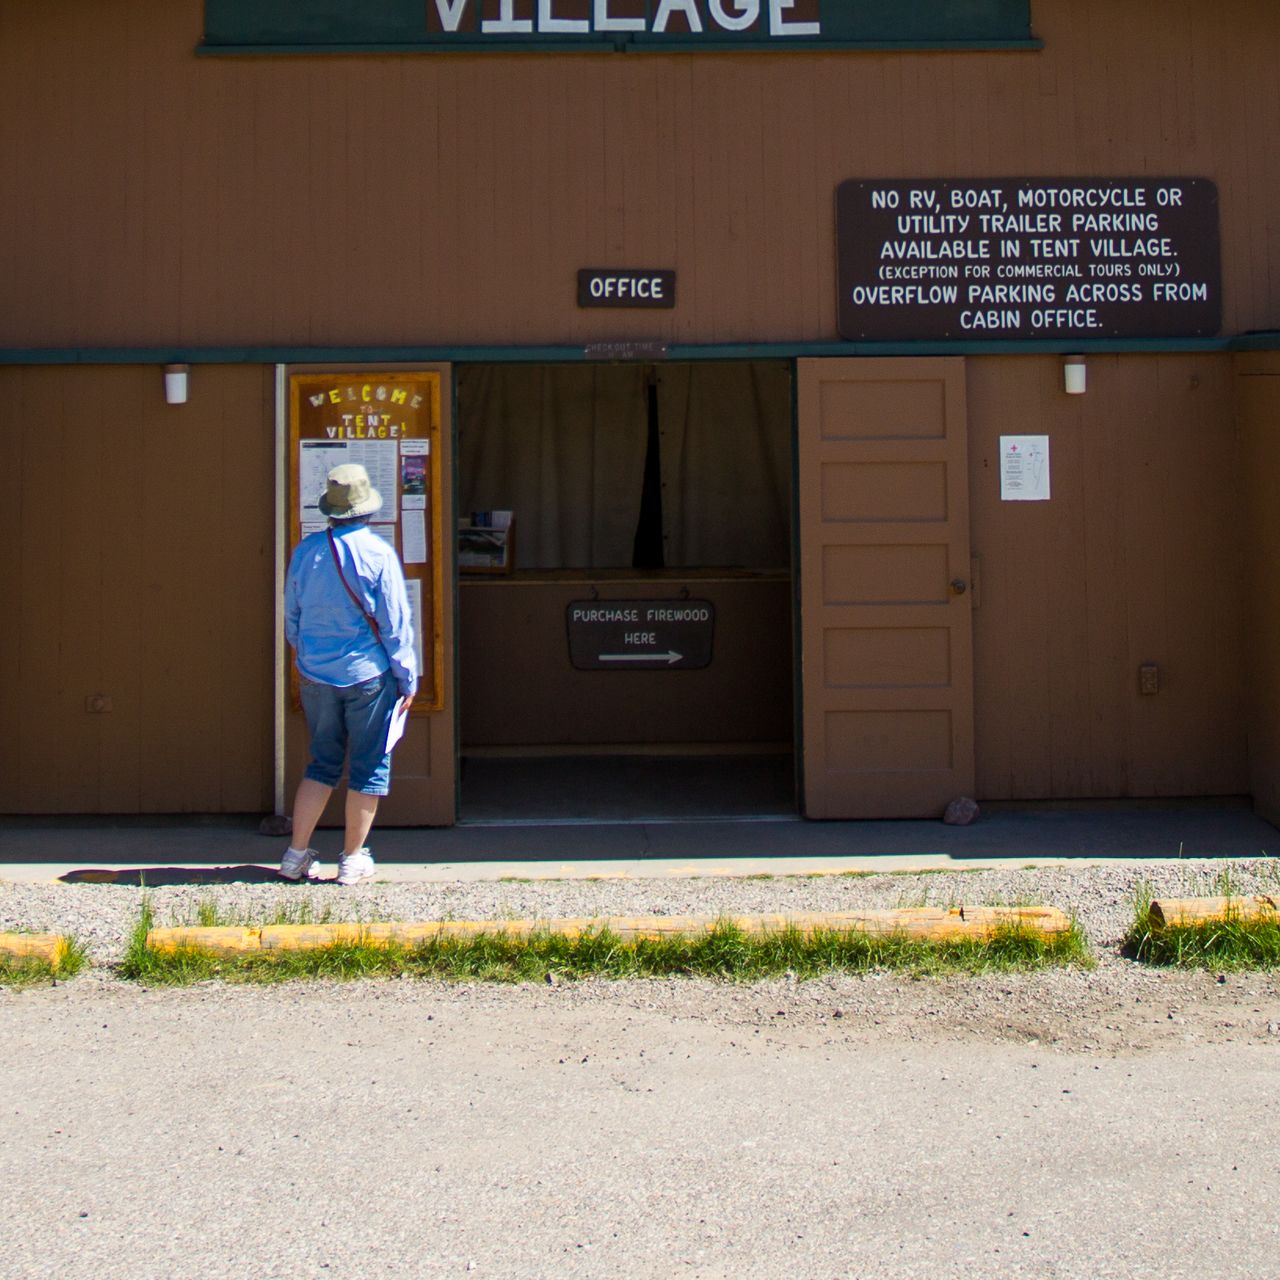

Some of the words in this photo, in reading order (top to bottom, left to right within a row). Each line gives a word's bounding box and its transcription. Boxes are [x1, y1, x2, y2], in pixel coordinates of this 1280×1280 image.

[872, 190, 899, 209] NO
[909, 190, 941, 213] RV,
[951, 190, 1008, 213] BOAT,
[1018, 188, 1146, 207] MOTORCYCLE
[1157, 188, 1183, 206] OR
[897, 215, 970, 234] UTILITY
[979, 214, 1062, 233] TRAILER
[1072, 214, 1158, 232] PARKING
[880, 240, 990, 259] AVAILABLE
[1001, 240, 1020, 258] IN
[1030, 239, 1080, 258] TENT
[1090, 238, 1178, 257] VILLAGE.
[878, 265, 958, 280] (EXCEPTION
[965, 265, 991, 278] FOR
[997, 264, 1083, 278] COMMERCIAL
[1089, 264, 1132, 277] TOURS
[1138, 262, 1181, 277] ONLY)
[590, 277, 663, 298] OFFICE
[852, 286, 958, 305] OVERFLOW
[968, 285, 1056, 303] PARKING
[1066, 284, 1143, 302] ACROSS
[1153, 283, 1208, 301] FROM
[960, 310, 1020, 329] CABIN
[1031, 309, 1104, 328] OFFICE.
[309, 384, 422, 409] WELCOME
[342, 414, 391, 426] TENT
[573, 610, 639, 622] PURCHASE
[647, 609, 709, 621] FIREWOOD
[624, 633, 657, 644] HERE
